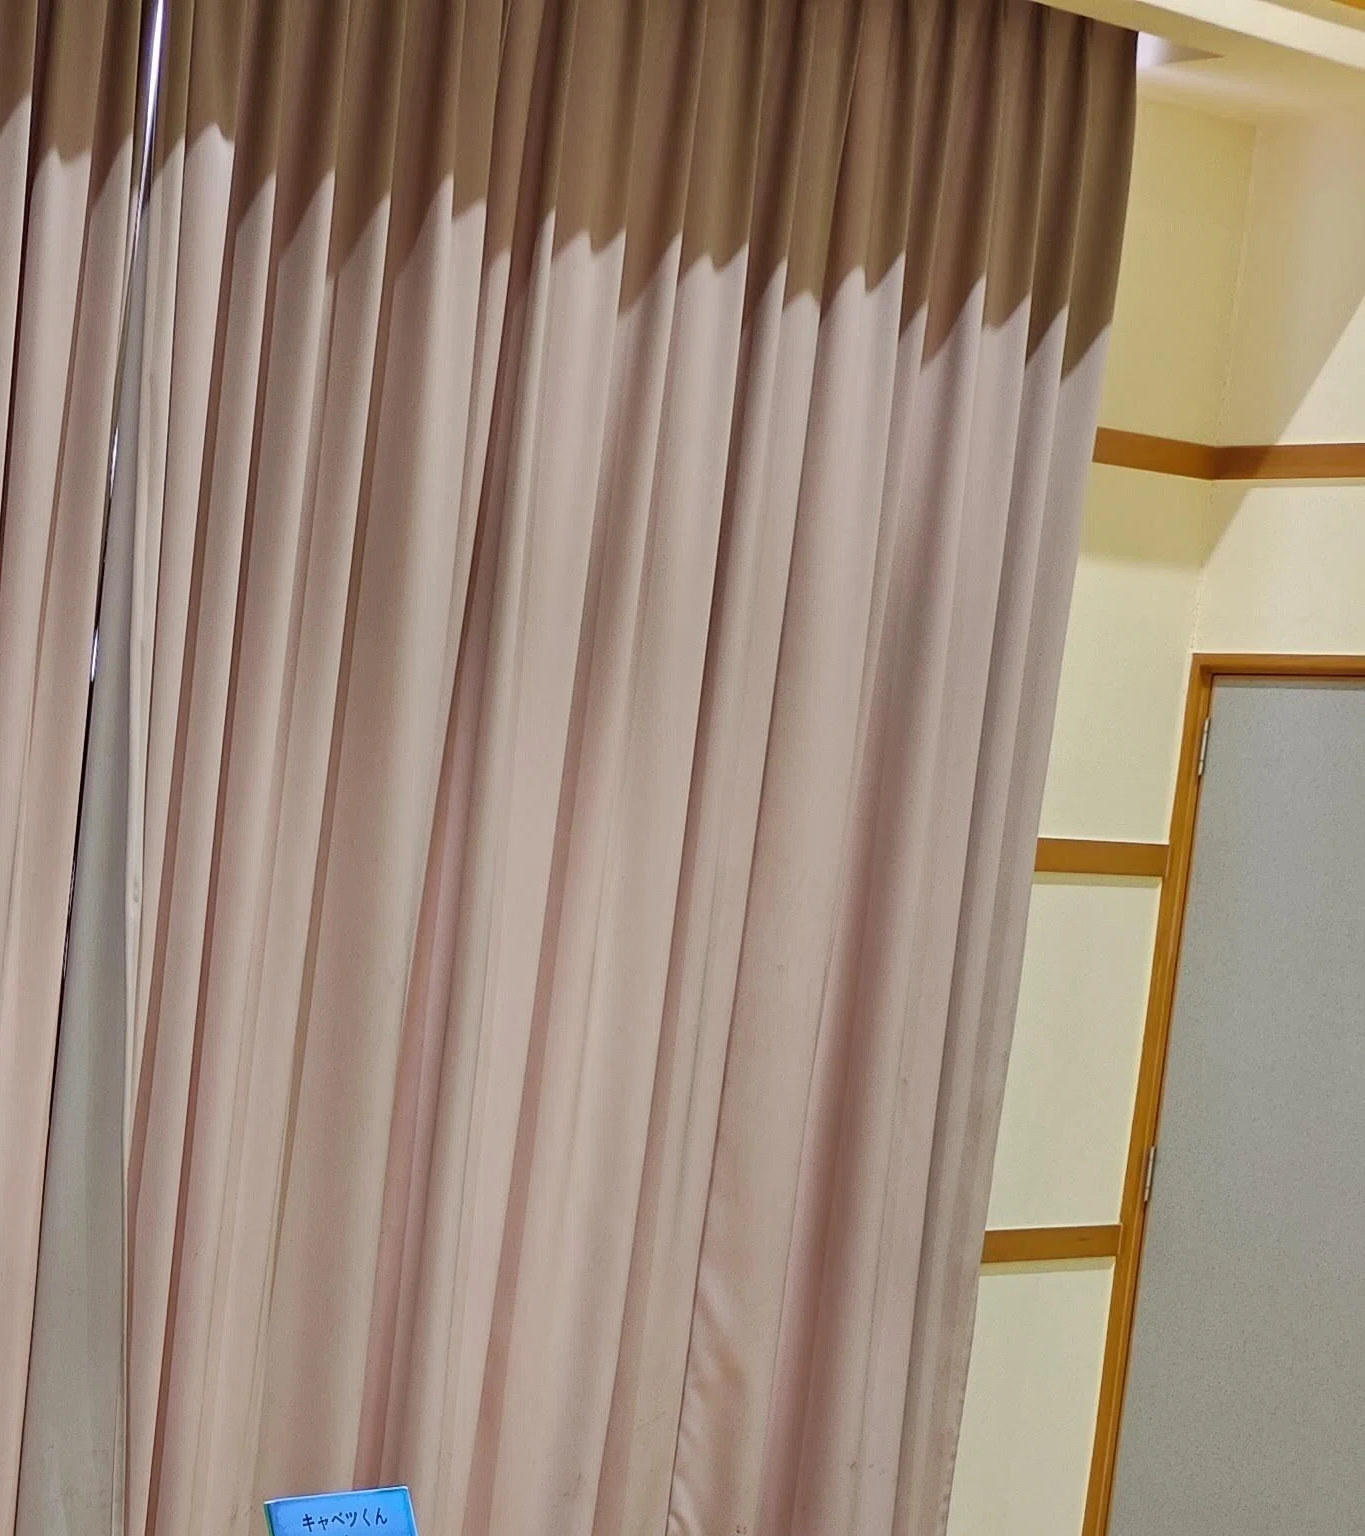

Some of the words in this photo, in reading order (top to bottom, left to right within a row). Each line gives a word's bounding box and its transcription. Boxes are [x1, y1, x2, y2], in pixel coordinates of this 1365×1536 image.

[302, 1507, 388, 1533] キャベツくん
